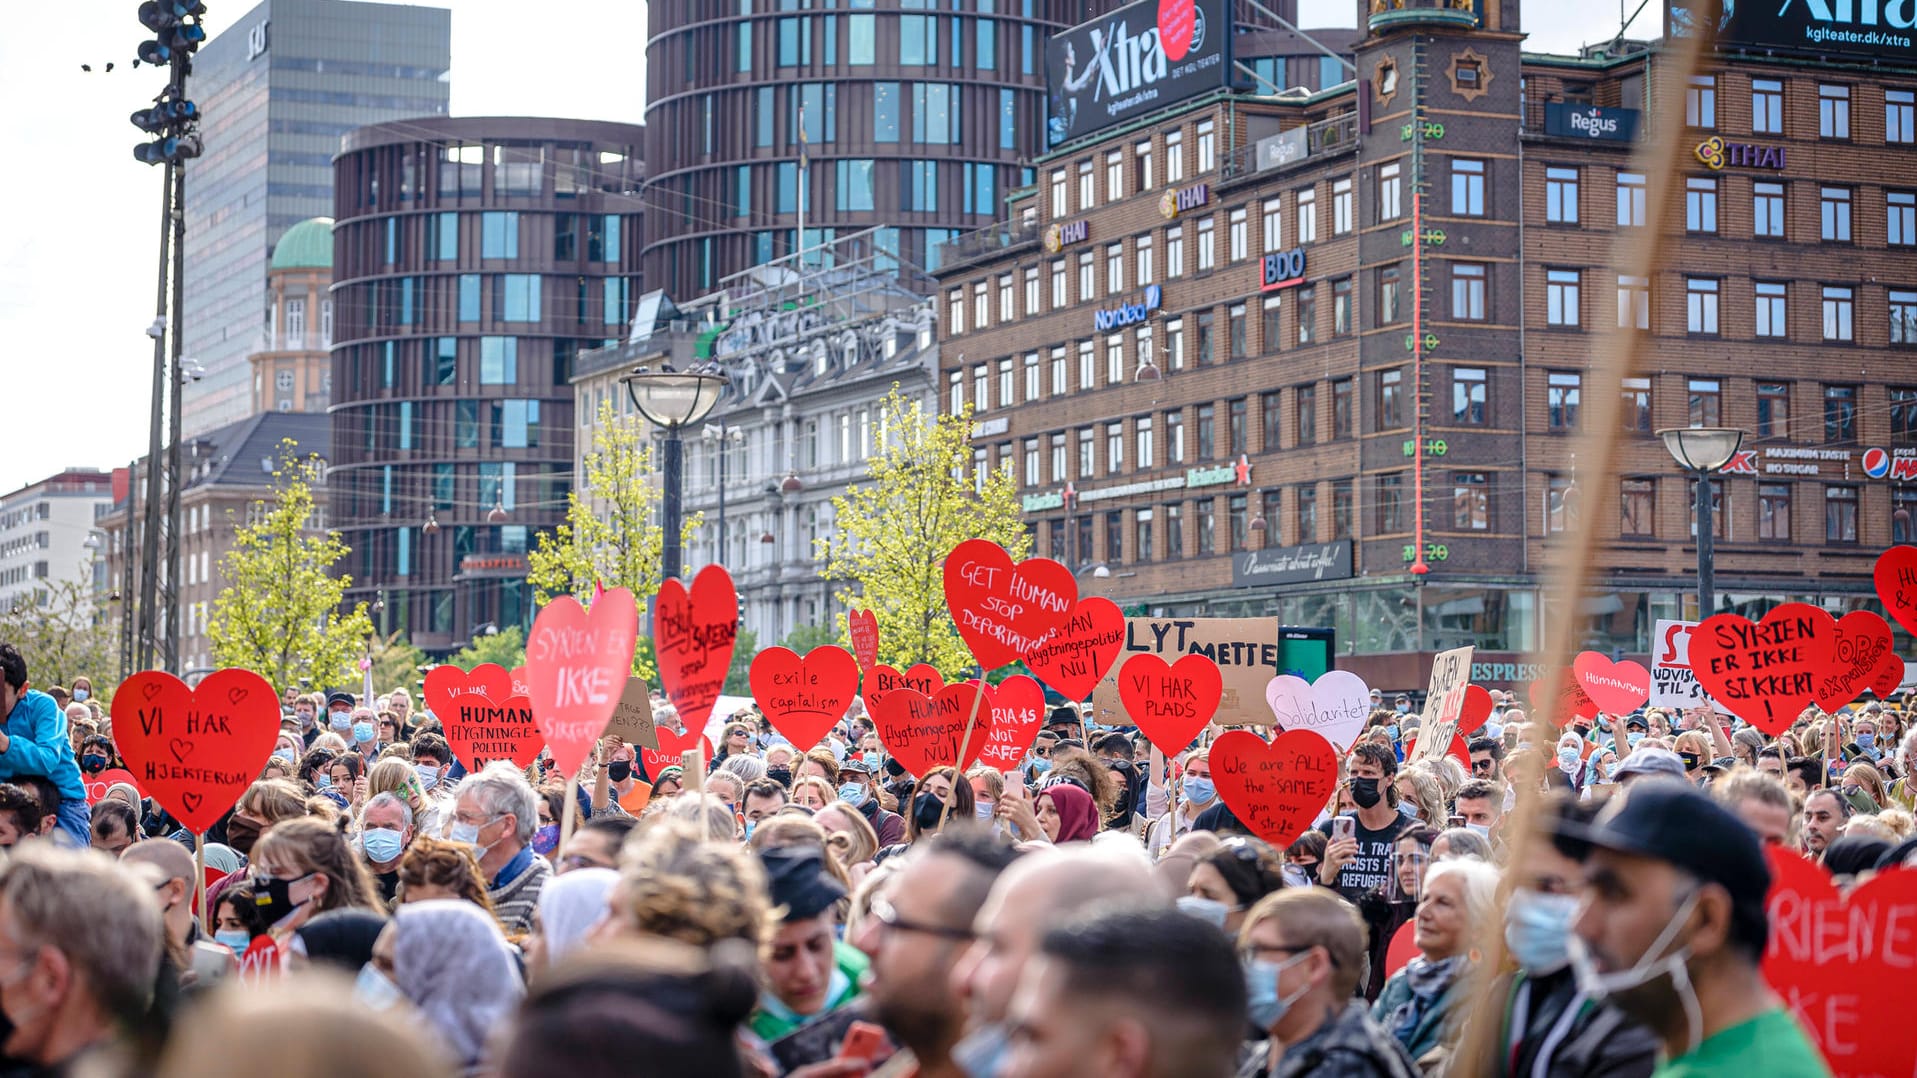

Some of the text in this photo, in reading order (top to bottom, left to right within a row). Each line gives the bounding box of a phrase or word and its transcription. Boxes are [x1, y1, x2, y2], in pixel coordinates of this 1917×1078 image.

[1806, 25, 1911, 47] kglteater.dk/xtra
[1089, 20, 1167, 102] Xtra
[1425, 123, 1444, 139] 20
[1571, 113, 1617, 138] Regus
[1725, 142, 1786, 169] THAI
[1176, 184, 1207, 211] THAI
[1060, 220, 1088, 246] THAI
[1265, 247, 1305, 284] BDO
[1095, 301, 1147, 332] Nordea
[1428, 440, 1447, 455] 10
[1783, 464, 1819, 475] SUGAR
[1428, 544, 1447, 560] 20
[961, 560, 1069, 612] GET HUMAN
[980, 596, 1023, 622] STOP
[1126, 621, 1195, 653] LYT
[1714, 617, 1815, 650] SYRIEN
[1189, 641, 1278, 668] METTE
[1711, 647, 1804, 674] ER IKKE
[555, 665, 614, 708] IKKE
[773, 667, 819, 685] exile
[1133, 674, 1198, 701] VI HAR
[1585, 671, 1647, 698] HUMANISME
[1657, 682, 1684, 695] TIL
[1725, 671, 1815, 699] SIKKERT
[447, 687, 460, 698] VI
[770, 690, 840, 713] capitalism
[460, 706, 533, 723] HUMAN
[909, 694, 960, 720] HUMAN
[1146, 701, 1197, 718] PLADS
[1274, 694, 1367, 729] Solidaritet
[1763, 700, 1774, 723] !
[138, 709, 232, 736] VI HAR
[990, 728, 1018, 743] NOT
[472, 742, 518, 754] POLITIK
[983, 744, 1022, 761] SAFE
[146, 761, 248, 787] HJERTERUM
[1223, 756, 1247, 775] We
[1260, 761, 1283, 771] are
[1244, 778, 1265, 793] the
[1248, 803, 1301, 820] join our
